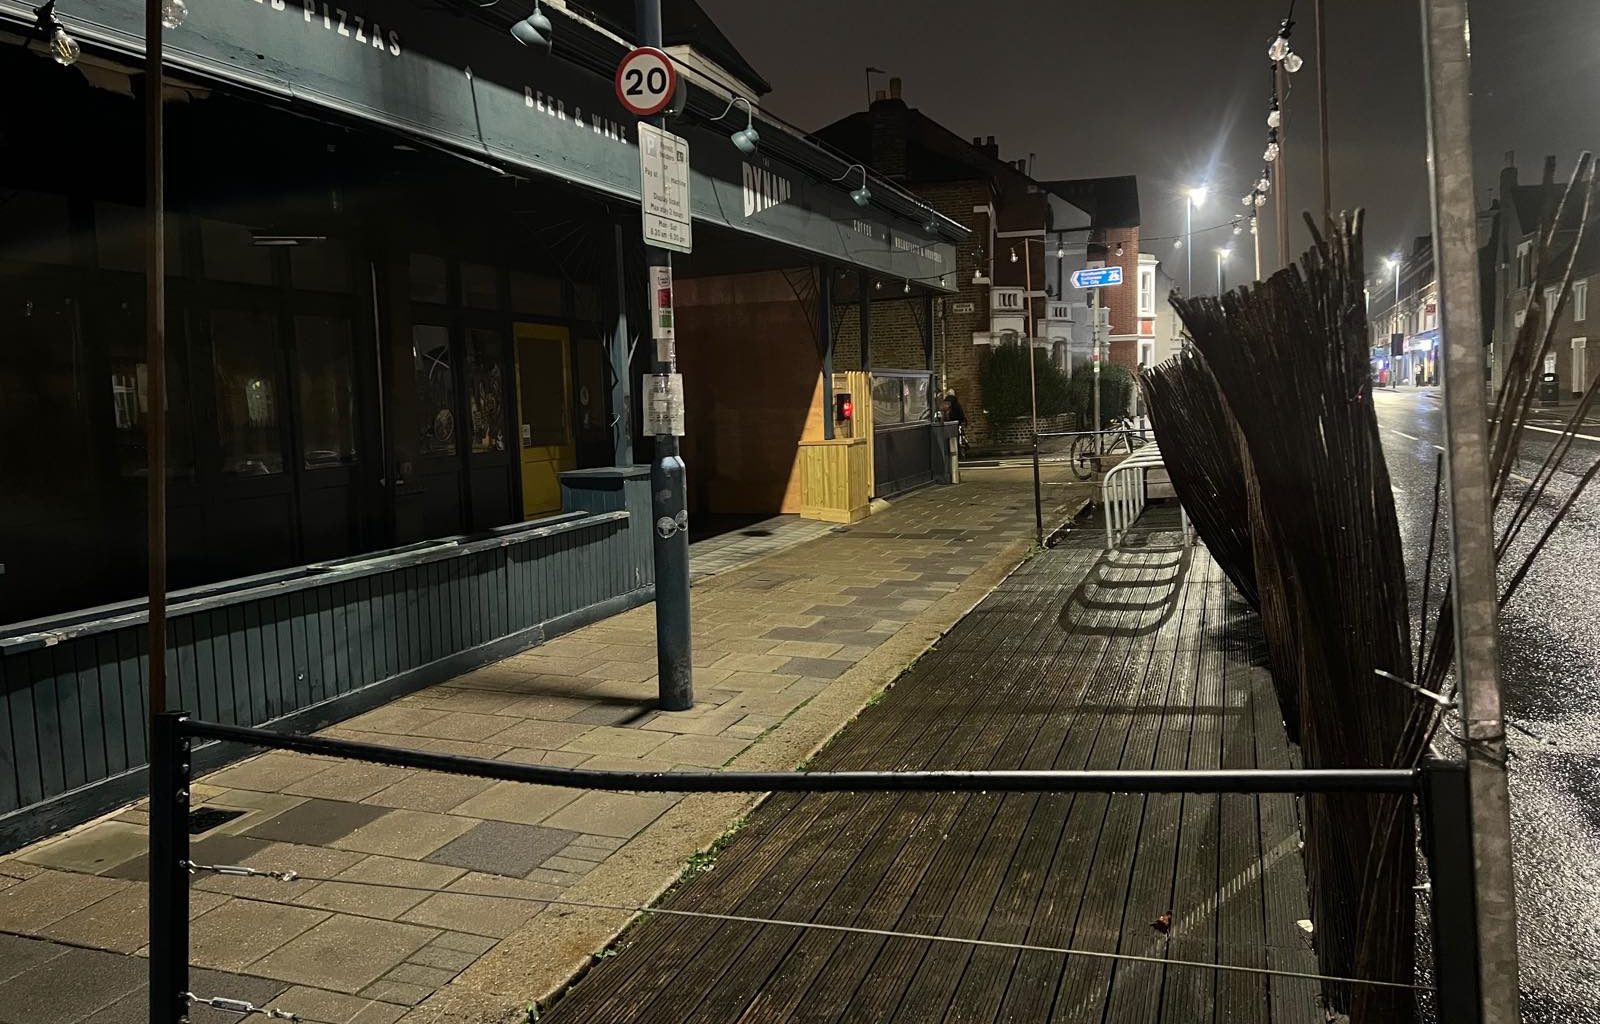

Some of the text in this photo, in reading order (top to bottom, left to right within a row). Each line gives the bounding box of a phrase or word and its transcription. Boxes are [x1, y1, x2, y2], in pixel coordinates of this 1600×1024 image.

[302, 0, 401, 57] PIZZAS
[625, 67, 667, 96] 20
[524, 86, 627, 144] BEER & WINE
[742, 160, 791, 218] DYNAMO
